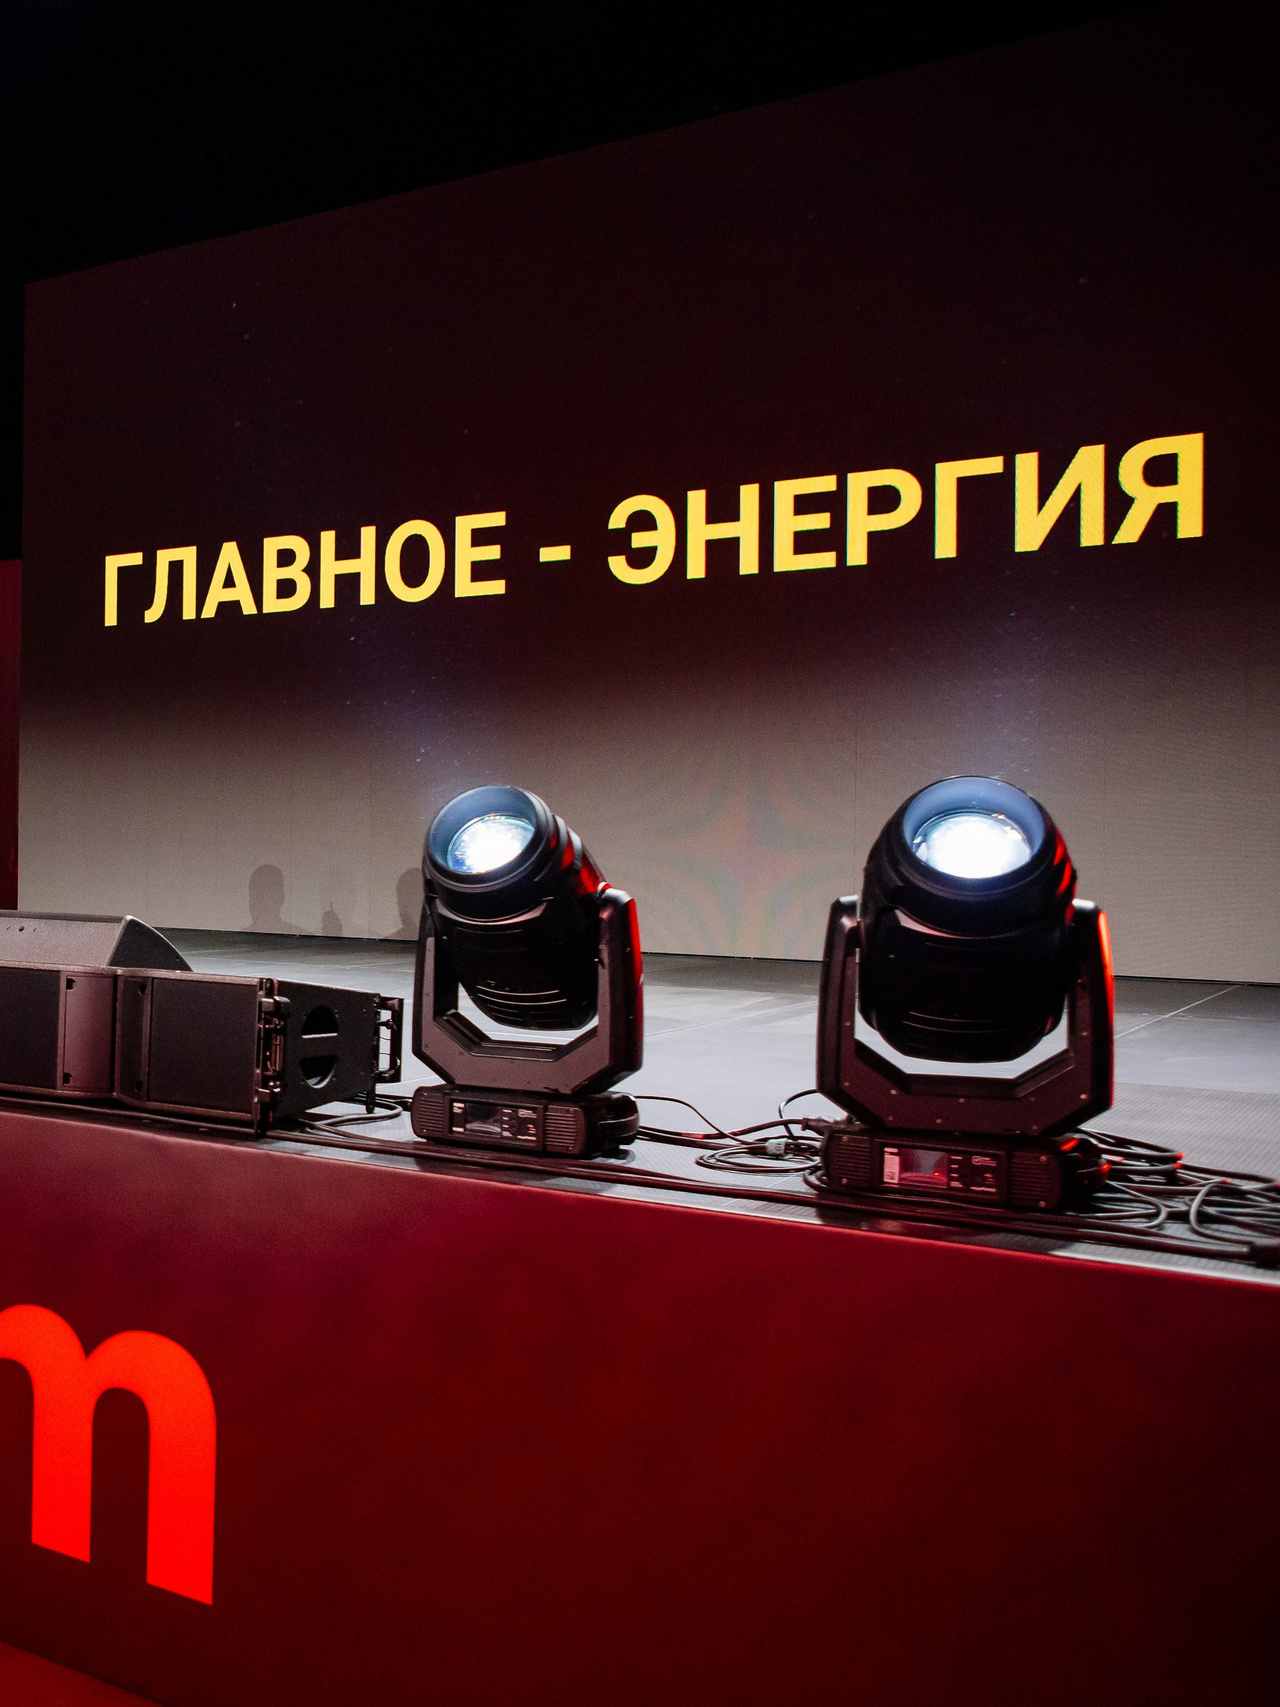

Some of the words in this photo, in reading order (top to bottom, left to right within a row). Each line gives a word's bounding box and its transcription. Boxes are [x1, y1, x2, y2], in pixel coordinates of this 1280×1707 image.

[103, 510, 508, 628] ГЛАВНОЕ
[538, 543, 573, 564] -
[606, 432, 1206, 587] ЭНЕРГИЯ
